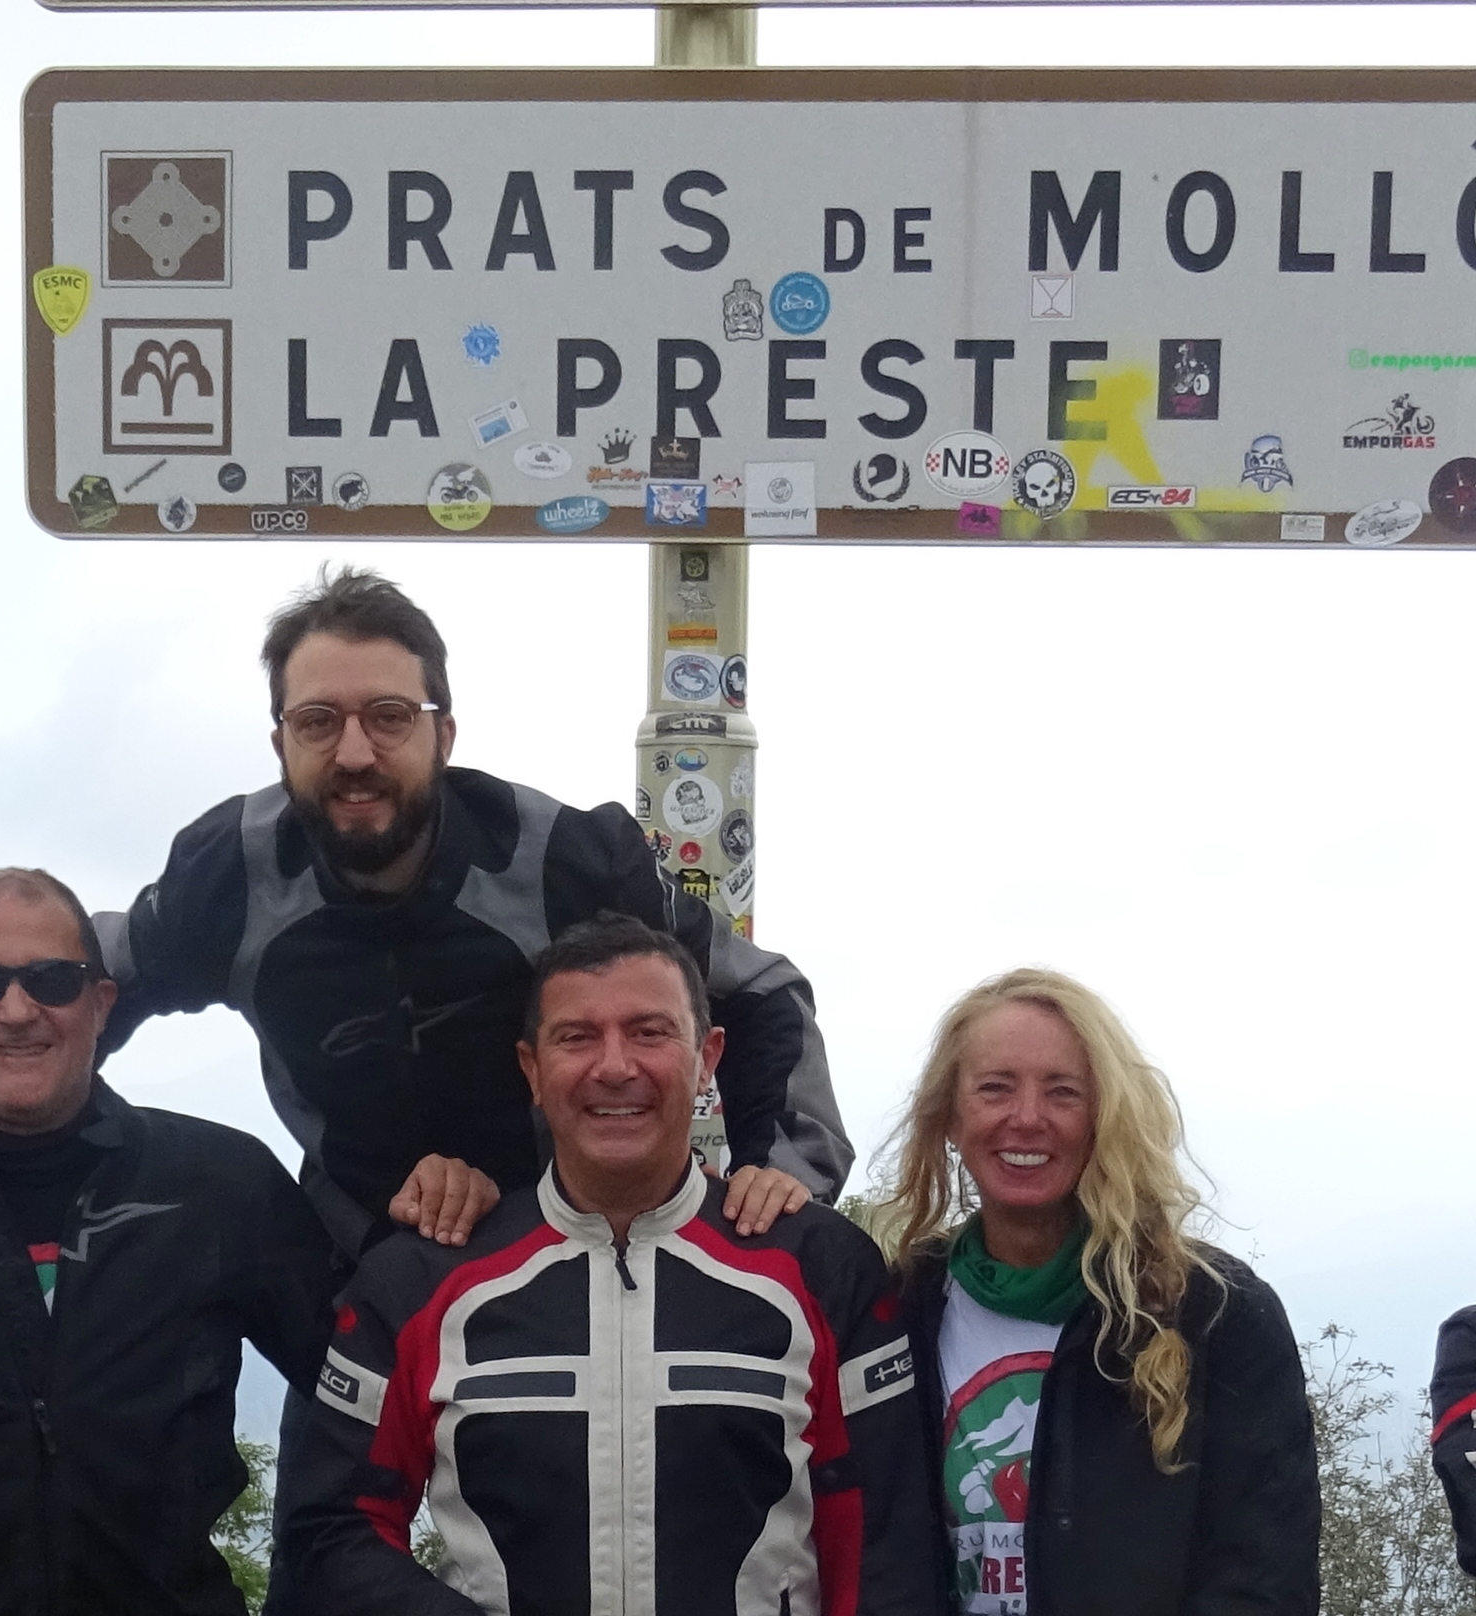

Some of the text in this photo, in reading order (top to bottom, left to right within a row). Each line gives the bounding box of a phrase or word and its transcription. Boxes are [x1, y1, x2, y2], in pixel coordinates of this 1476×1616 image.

[289, 169, 730, 272] PRATS
[824, 208, 932, 272] DE
[42, 275, 82, 289] ESMC
[288, 338, 1109, 441] LA PRESTE
[1343, 436, 1435, 450] EMPORGAS
[942, 447, 993, 479] NB
